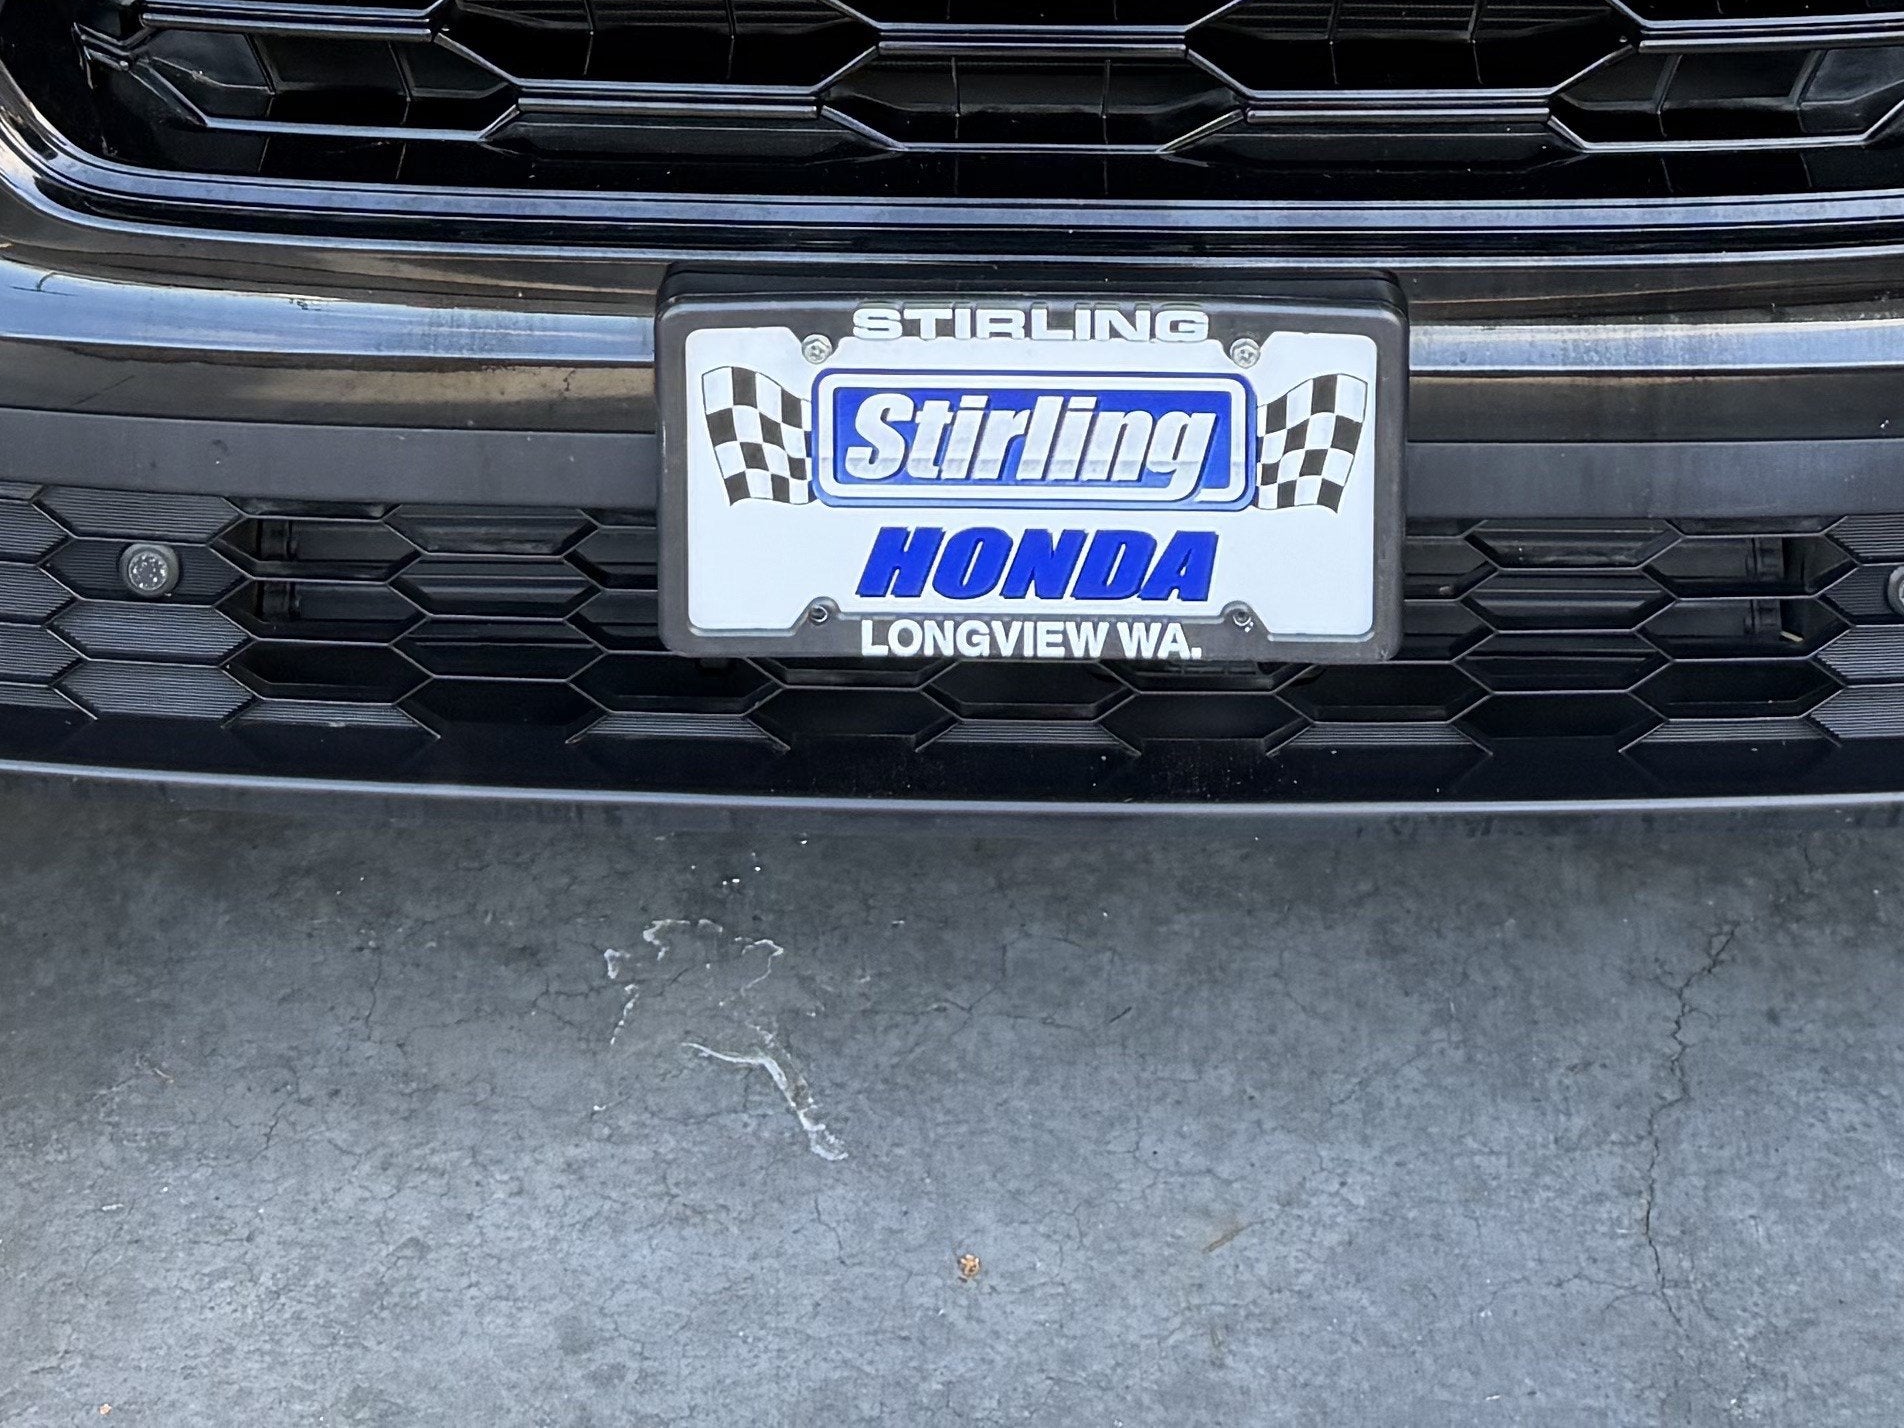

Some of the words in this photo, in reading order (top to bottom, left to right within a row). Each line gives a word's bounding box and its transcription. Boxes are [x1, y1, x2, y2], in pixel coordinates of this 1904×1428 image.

[853, 306, 1209, 342] STIRLING
[846, 393, 1217, 500] Stirling
[855, 527, 1218, 601] HONDA
[861, 619, 1108, 657] LONGVIEW
[1117, 621, 1202, 658] WA.
